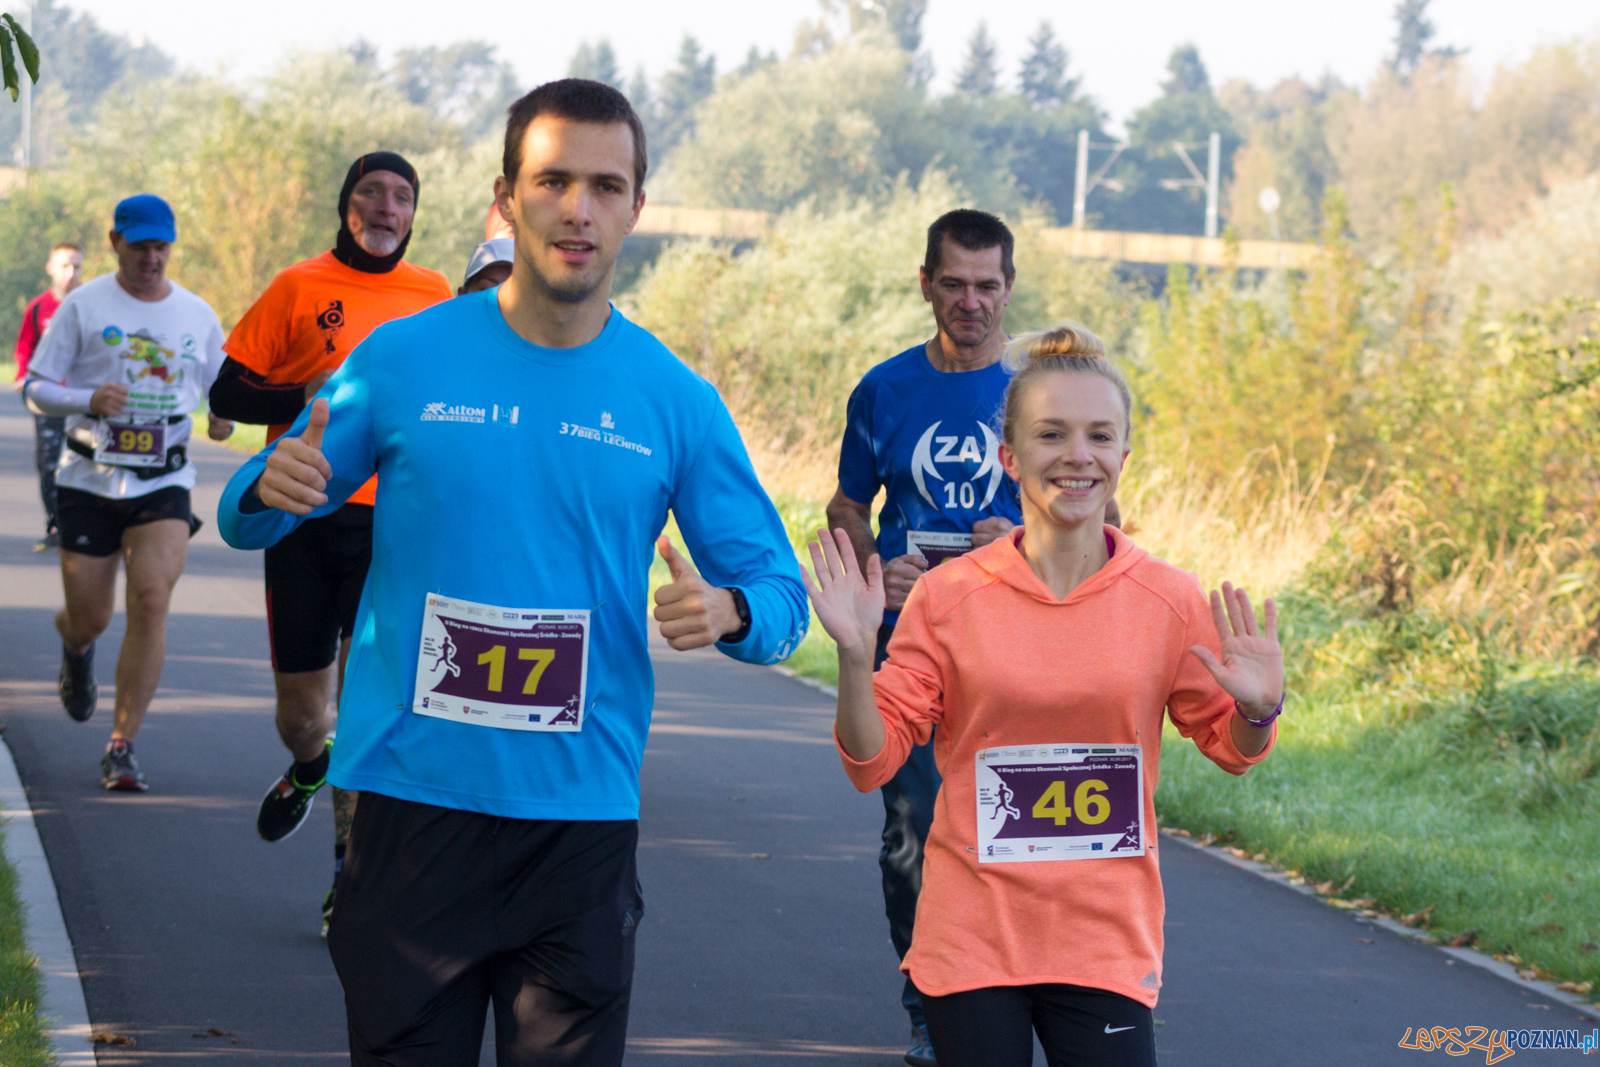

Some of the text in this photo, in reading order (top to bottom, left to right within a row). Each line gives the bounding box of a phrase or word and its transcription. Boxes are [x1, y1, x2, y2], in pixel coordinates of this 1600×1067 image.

[119, 429, 154, 453] 99
[559, 421, 580, 436] 37
[577, 428, 601, 442] BIEG
[603, 435, 653, 457] LECHITÓW
[934, 435, 983, 463] ZA
[943, 481, 975, 509] 10
[449, 620, 462, 631] Bieg
[469, 625, 483, 633] rzecz
[483, 626, 510, 637] Ekonomii
[510, 631, 540, 640] Społecznej
[540, 630, 559, 639] Śródka
[561, 632, 582, 640] Zawady
[477, 644, 556, 695] 17
[1062, 764, 1092, 772] Społecznej
[1031, 779, 1111, 826] 46
